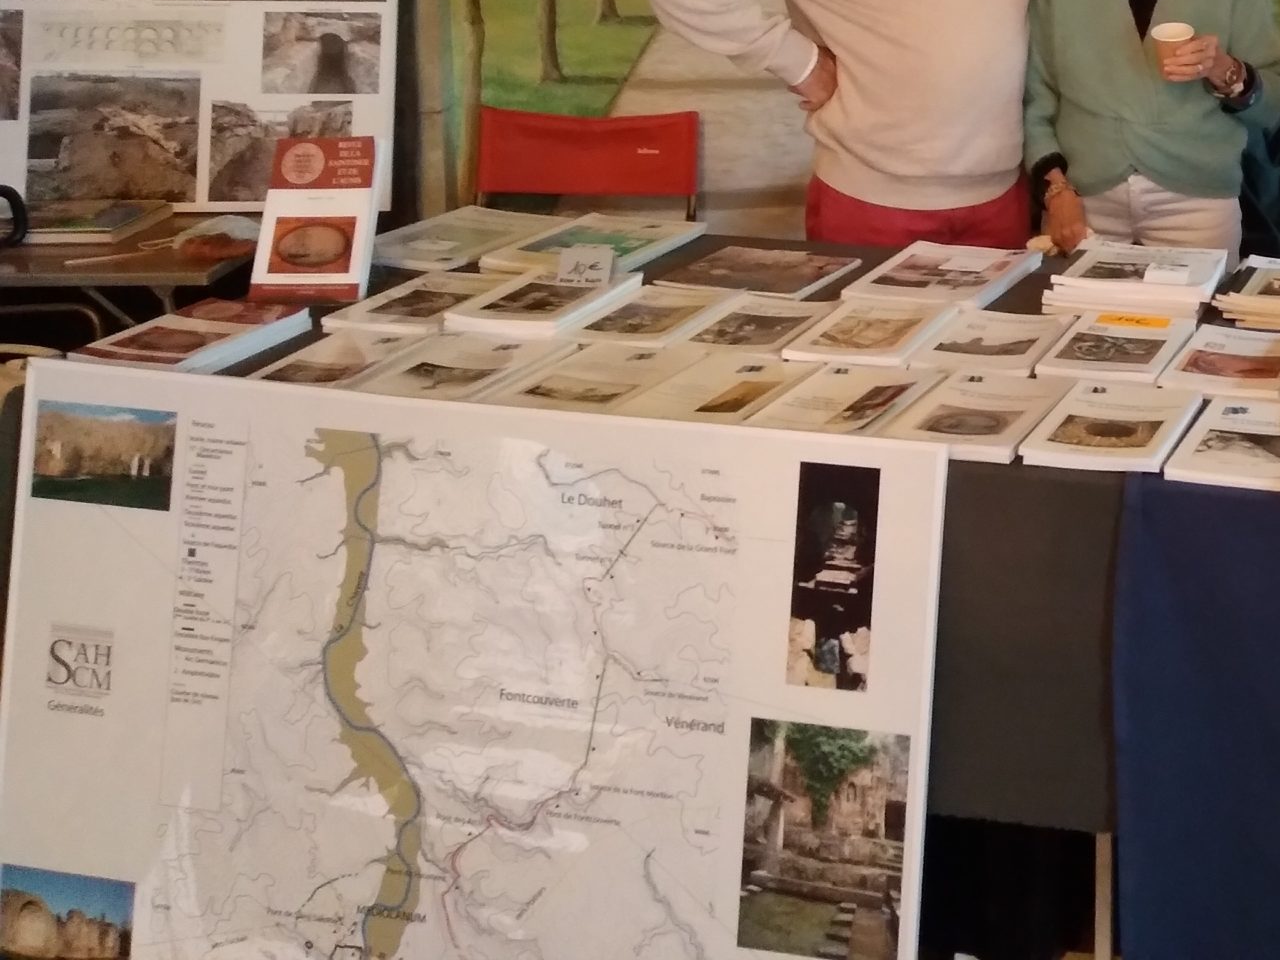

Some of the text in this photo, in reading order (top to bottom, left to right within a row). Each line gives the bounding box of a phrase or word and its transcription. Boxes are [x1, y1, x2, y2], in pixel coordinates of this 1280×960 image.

[561, 492, 623, 510] Le Douhet
[499, 688, 579, 710] Fontcouverte
[665, 715, 726, 735] Vénérand
